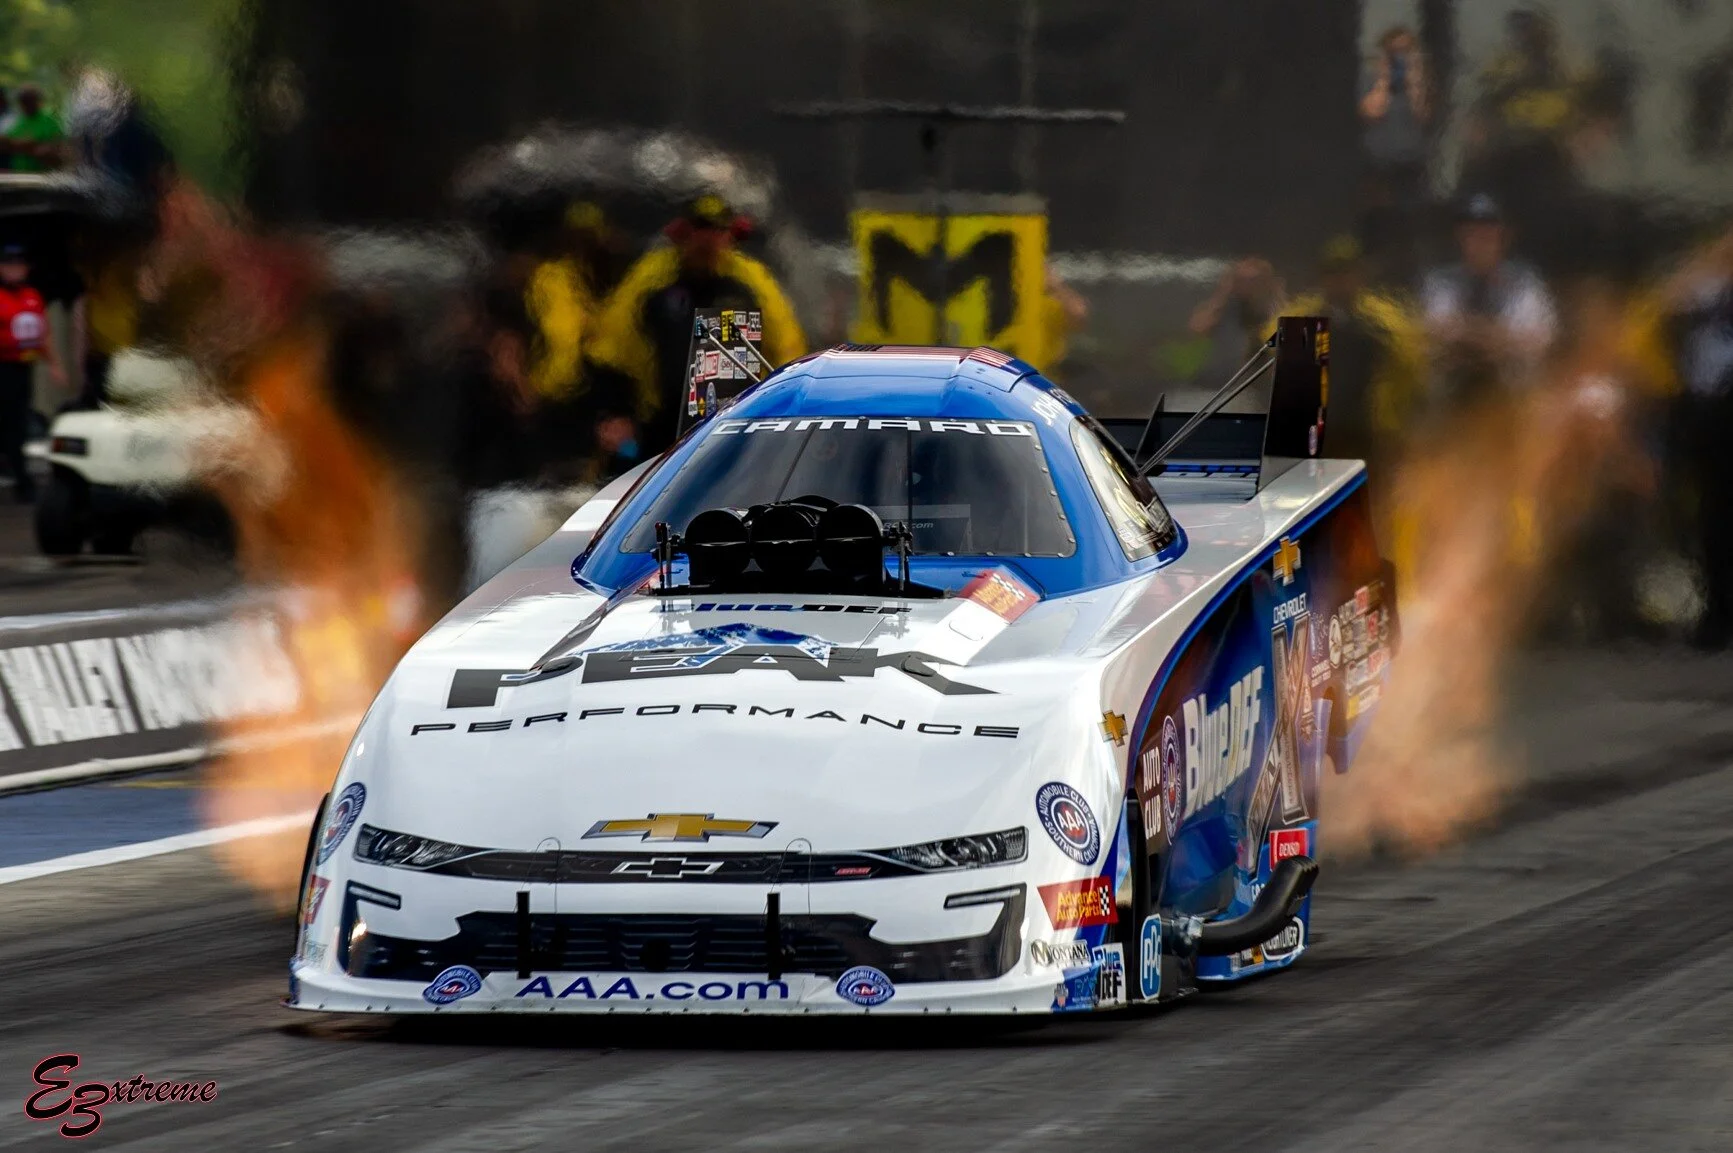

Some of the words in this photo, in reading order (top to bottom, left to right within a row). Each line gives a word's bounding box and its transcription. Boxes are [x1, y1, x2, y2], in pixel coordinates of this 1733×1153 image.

[712, 419, 1032, 437] CAMARO
[1273, 592, 1306, 625] CHEVROLET
[446, 643, 1002, 709] PEAK
[410, 702, 1021, 737] PERFORMANCE
[1143, 746, 1161, 793] AUTO
[1038, 784, 1070, 817] AUTOMOBILE
[1070, 789, 1089, 814] CLUB
[1144, 794, 1162, 840] CLUB
[1057, 810, 1084, 831] AAA
[1044, 821, 1084, 862] SOUTHERN
[1083, 818, 1099, 863] CALIFORNIA
[1279, 842, 1300, 857] DENSO
[1056, 903, 1080, 921] Auto
[1079, 902, 1101, 919] Parts
[1057, 889, 1098, 906] Advance
[516, 976, 790, 1001] AAA.com
